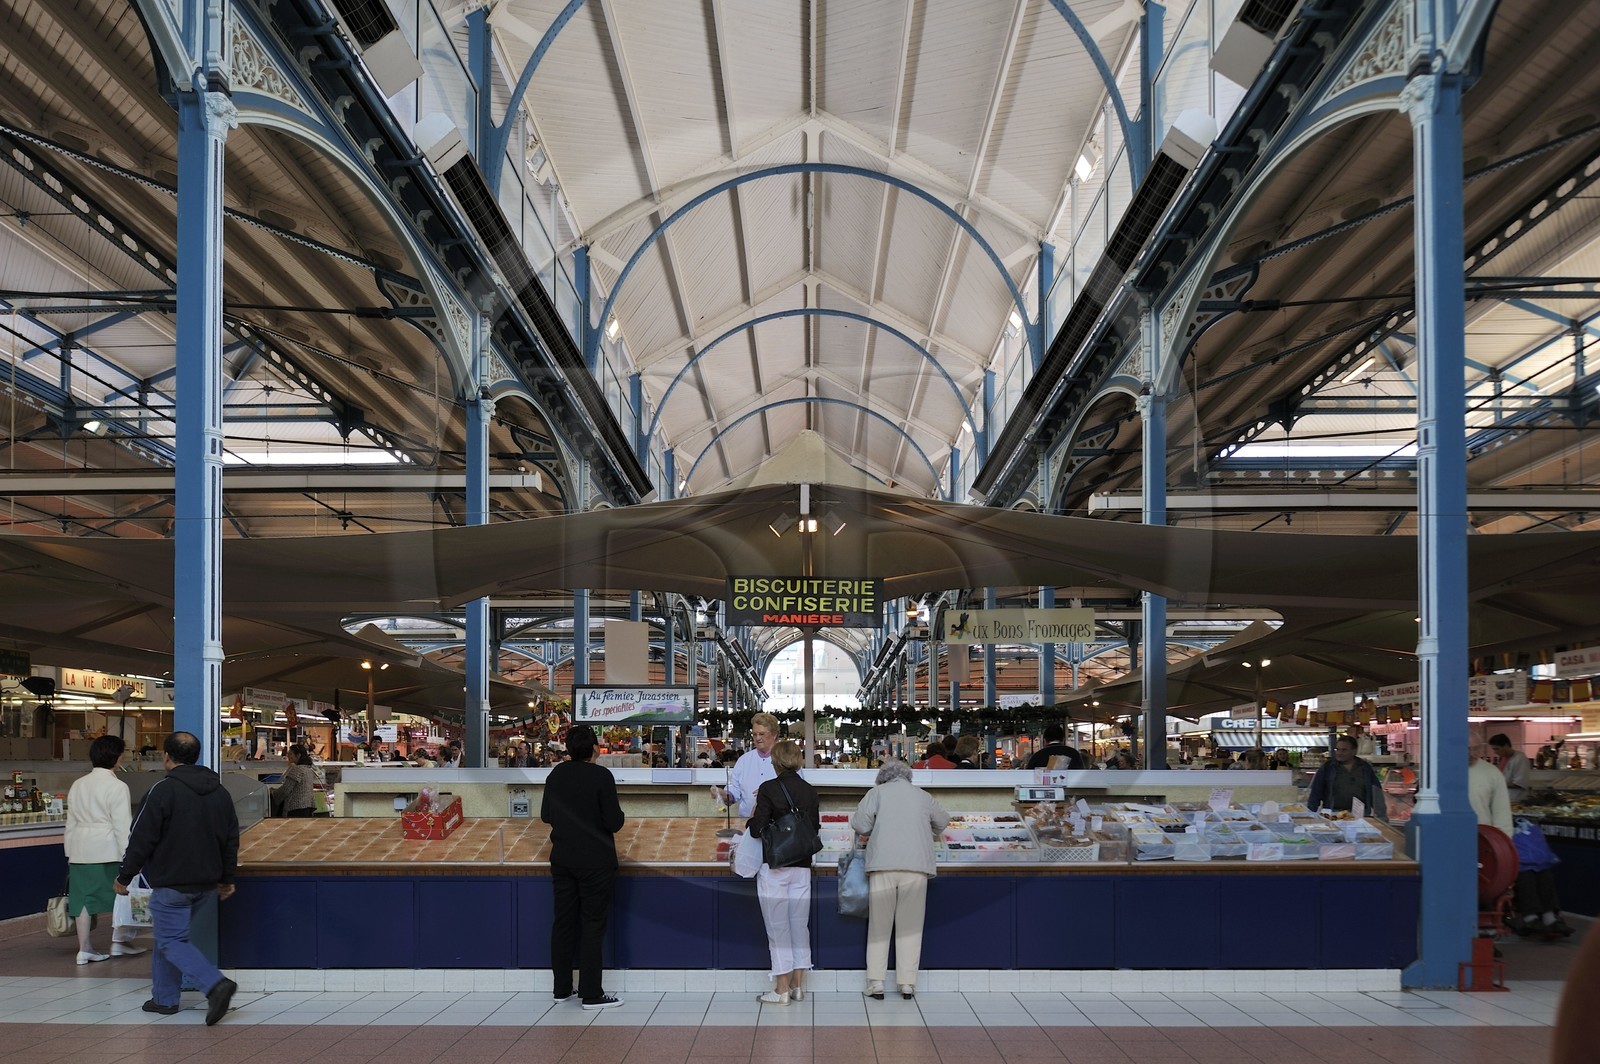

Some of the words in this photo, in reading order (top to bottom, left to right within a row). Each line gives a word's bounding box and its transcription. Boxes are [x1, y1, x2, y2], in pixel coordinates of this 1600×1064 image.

[734, 578, 875, 596] BISCUITERIE
[733, 595, 875, 613] CONFISERIE
[762, 613, 844, 624] MANIÈRE
[993, 620, 1024, 639] Bons
[1028, 619, 1092, 642] Fromages
[1560, 654, 1585, 667] CASA
[65, 672, 76, 686] LA
[83, 675, 95, 688] VIE
[588, 690, 601, 700] Au
[601, 689, 635, 704] Fermier
[635, 690, 680, 703] Jurassien
[1380, 689, 1394, 697] CASA
